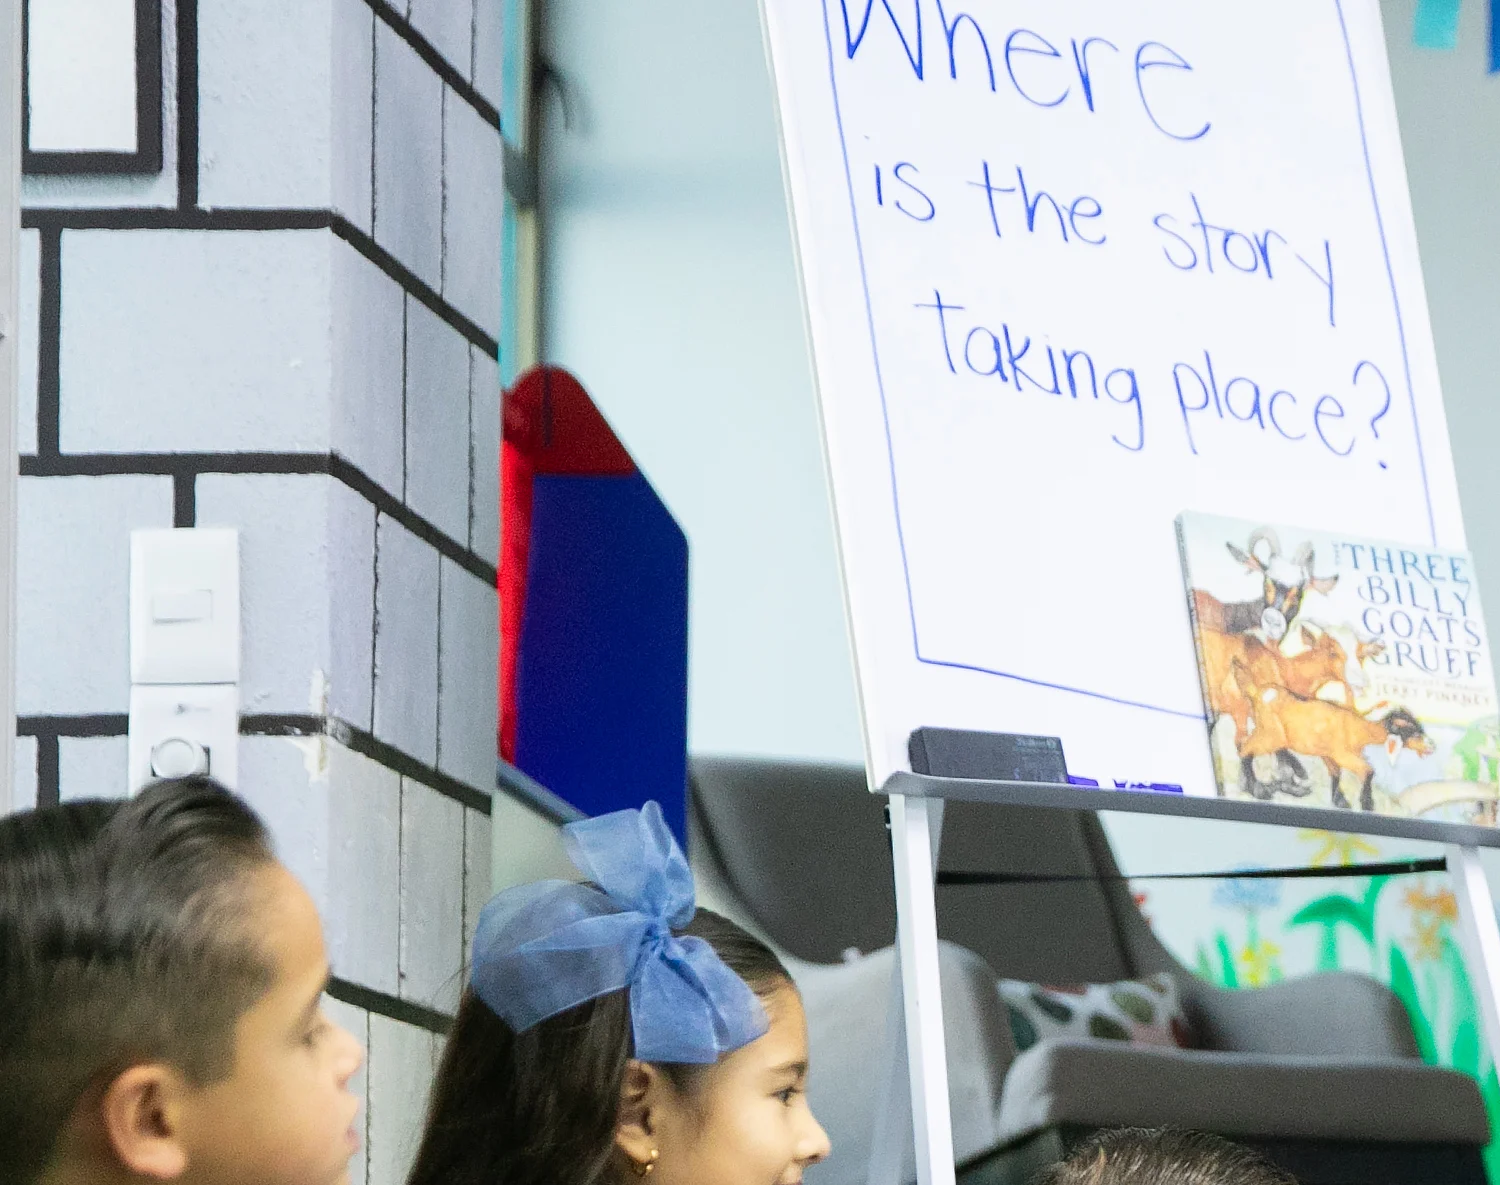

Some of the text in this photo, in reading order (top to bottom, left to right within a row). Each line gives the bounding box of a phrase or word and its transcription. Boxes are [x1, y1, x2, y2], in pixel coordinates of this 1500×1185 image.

[840, 0, 1212, 141] Where
[870, 152, 1338, 328] is the story
[914, 290, 1392, 470] taking place?
[1342, 543, 1471, 585] THREE
[1358, 575, 1471, 617] BILLY
[1362, 607, 1481, 648] GOATS
